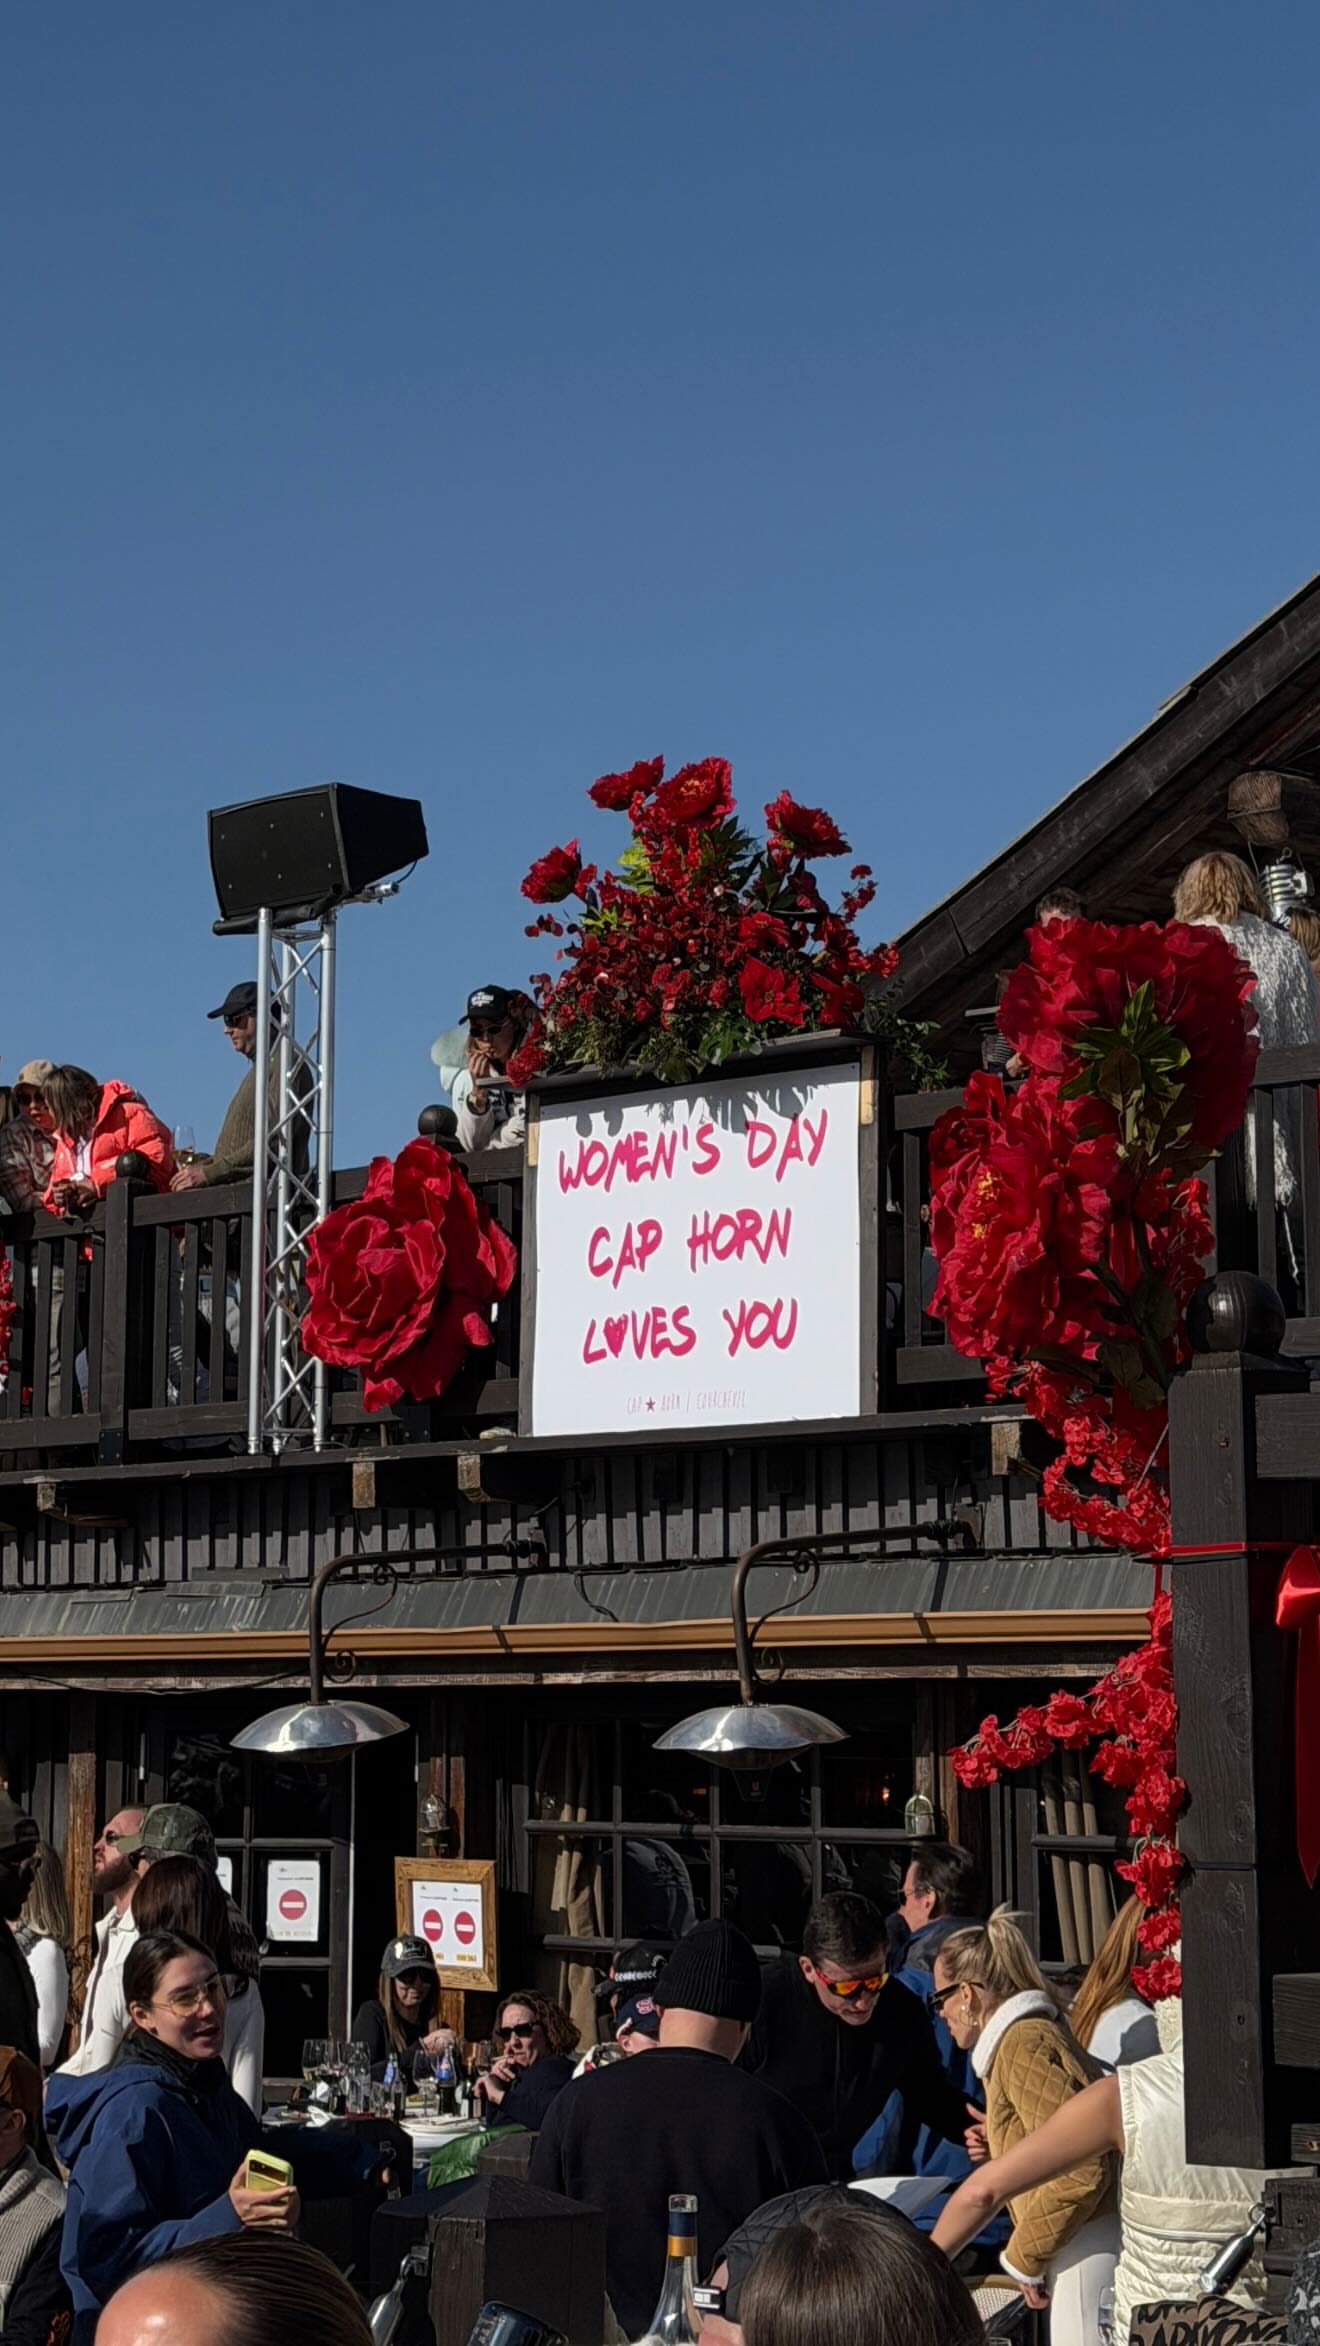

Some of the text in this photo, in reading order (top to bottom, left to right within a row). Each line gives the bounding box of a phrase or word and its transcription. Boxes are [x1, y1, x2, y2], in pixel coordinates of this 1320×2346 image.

[558, 1109, 829, 1194] WOMEN'S DAY
[588, 1207, 792, 1288] CAP HORN
[723, 1297, 798, 1357] YOU
